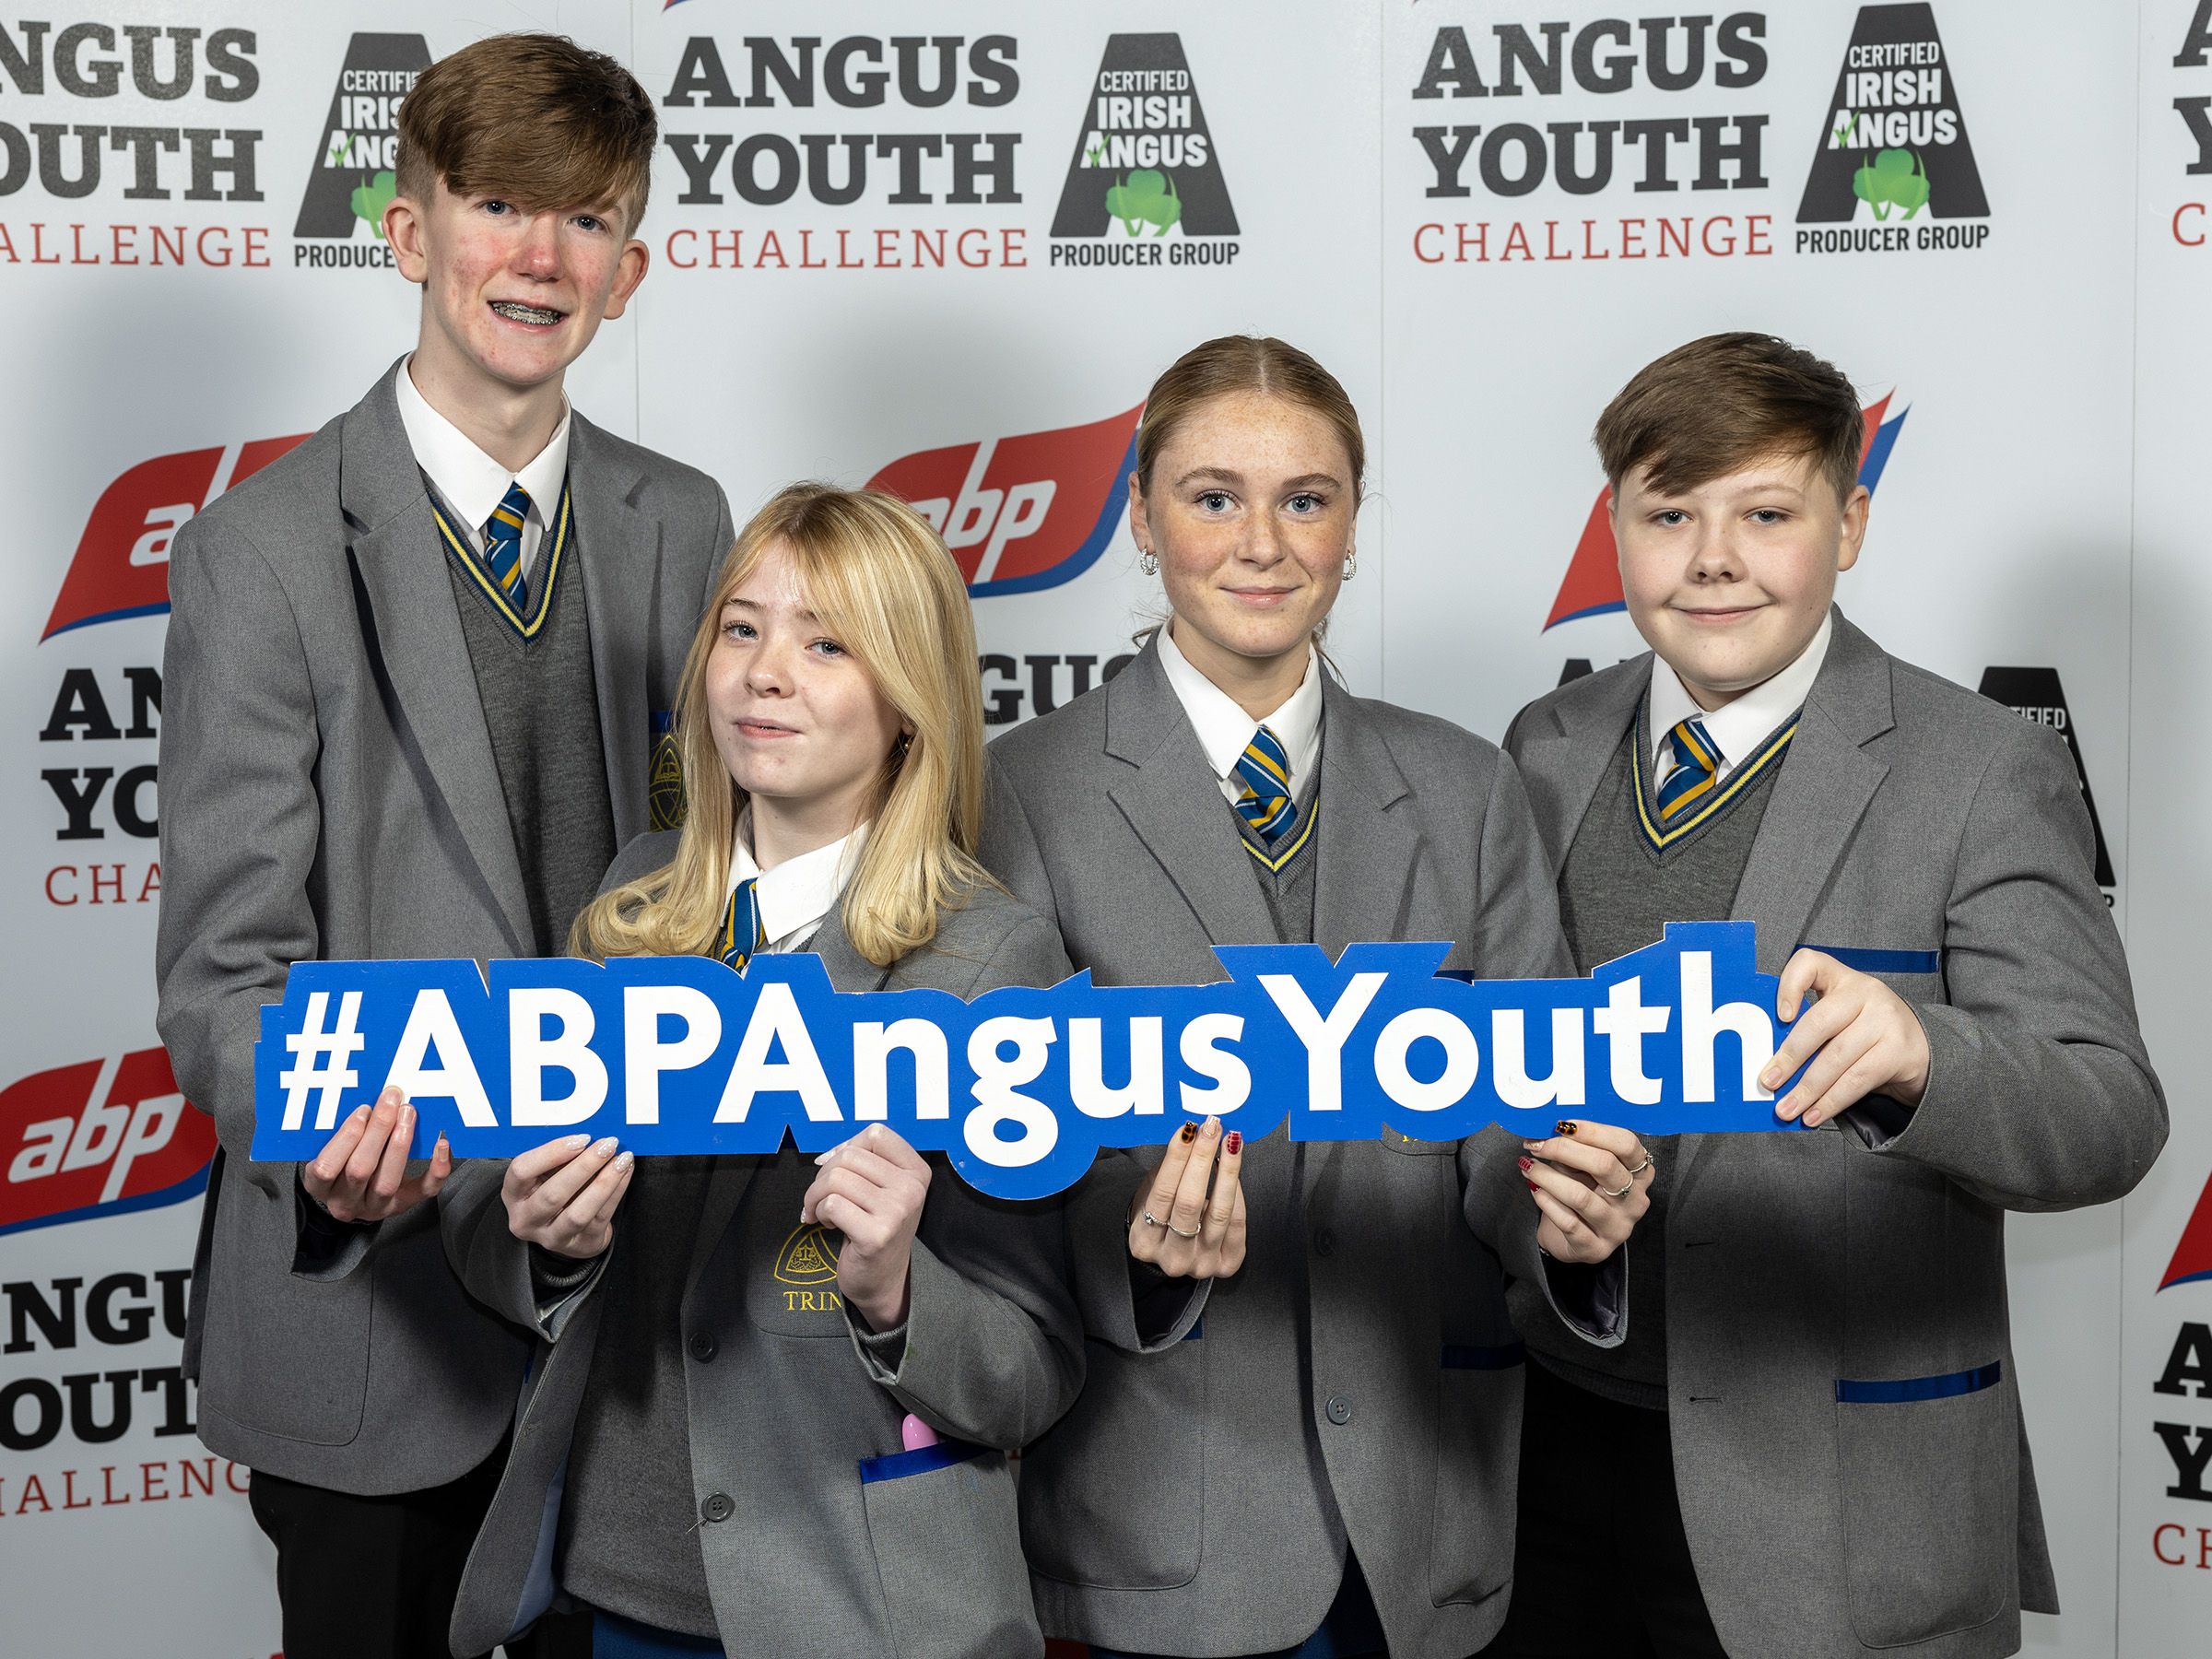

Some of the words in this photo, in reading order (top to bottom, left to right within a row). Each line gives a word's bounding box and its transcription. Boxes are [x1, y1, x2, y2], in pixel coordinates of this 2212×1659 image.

[663, 35, 1020, 109] ANGUS
[1412, 12, 1769, 100] ANGUS
[1849, 41, 1940, 68] CERTIFIED
[1100, 70, 1189, 91] CERTIFIED
[1846, 68, 1942, 108] IRISH
[1097, 96, 1192, 129] IRISH
[1828, 109, 1958, 149] ANGUS
[664, 134, 1022, 206] YOUTH
[1079, 131, 1207, 169] ANGUS
[1412, 114, 1769, 197] YOUTH
[665, 229, 1029, 269] CHALLENGE
[1051, 244, 1162, 266] PRODUCER
[1170, 243, 1240, 265] GROUP
[1413, 215, 1773, 264] CHALLENGE
[1795, 227, 1910, 253] PRODUCER
[1917, 224, 1990, 251] GROUP
[279, 951, 1775, 1168] #ABPAngusYouth
[7, 1052, 186, 1205] abp
[0, 1457, 251, 1516] ALLENG
